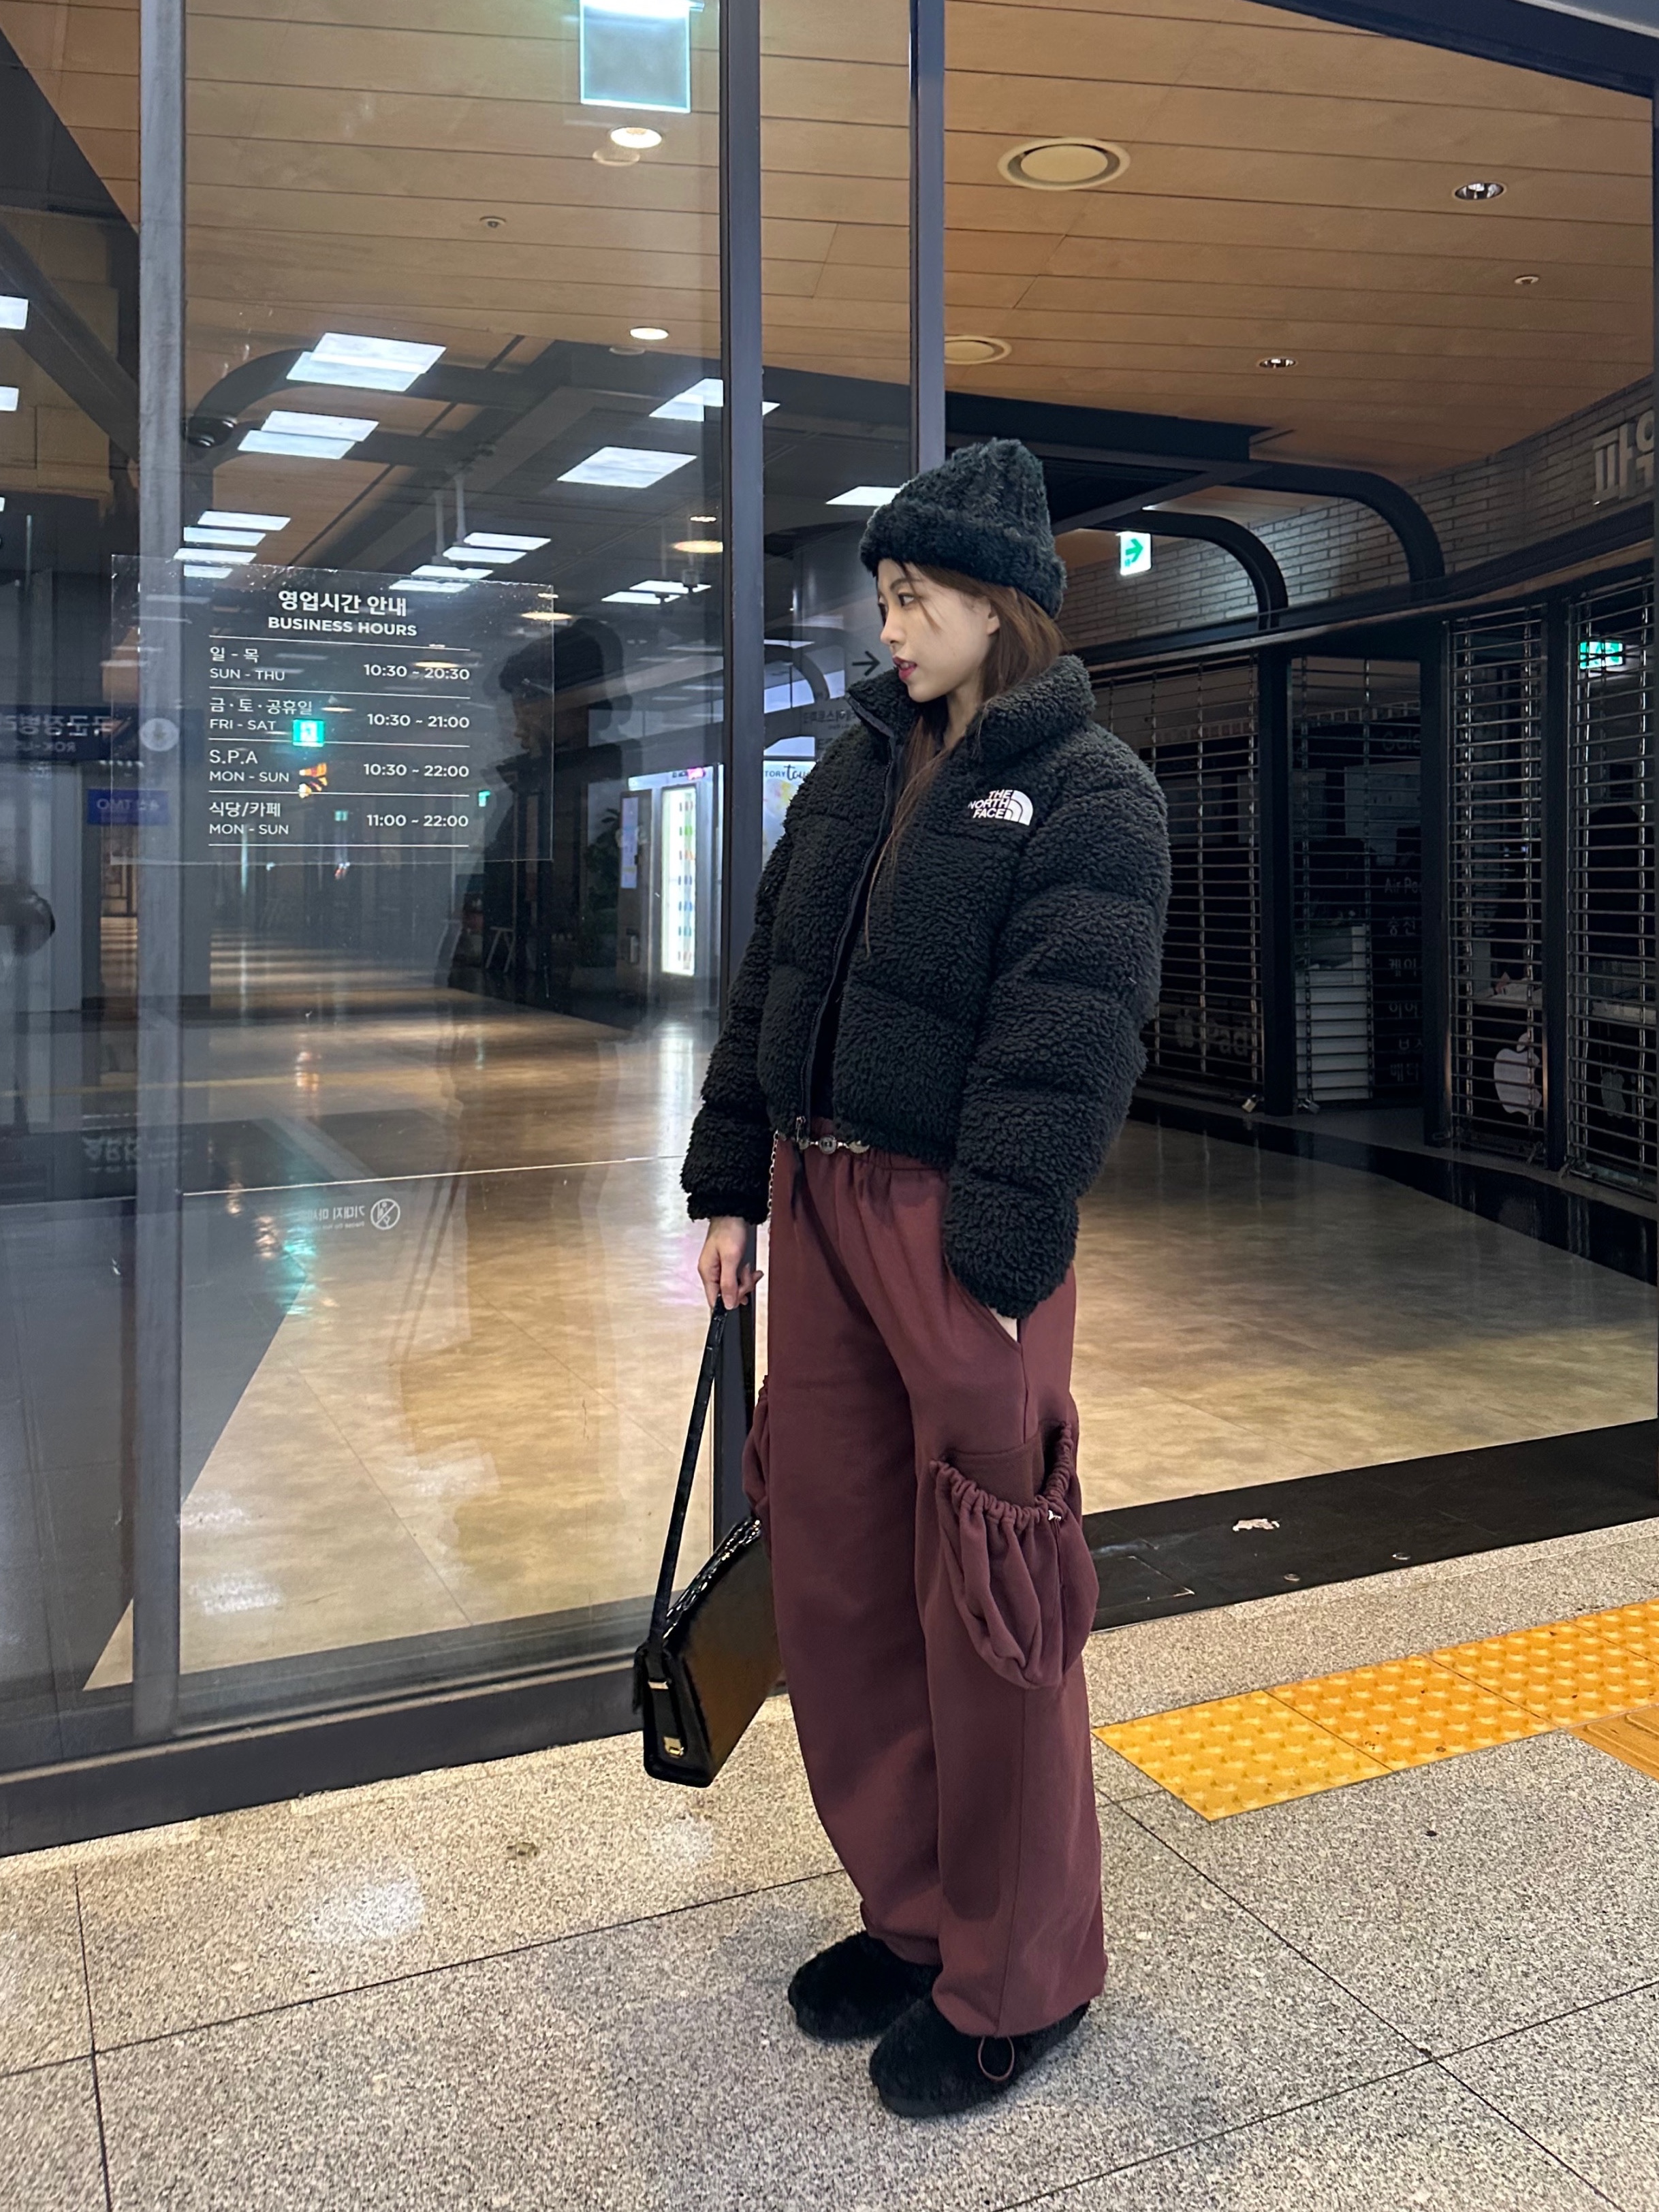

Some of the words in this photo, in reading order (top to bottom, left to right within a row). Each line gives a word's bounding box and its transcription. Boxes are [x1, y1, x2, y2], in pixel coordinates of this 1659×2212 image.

[278, 590, 362, 614] 영업시간
[366, 596, 407, 617] 안내
[268, 616, 353, 633] BUSINESS
[358, 622, 417, 636] HOURS
[209, 646, 225, 663] 일
[244, 648, 259, 663] 목
[209, 667, 240, 680] SUN
[255, 669, 285, 681] THU
[363, 663, 407, 678] 10:30
[424, 667, 471, 680] 20:30
[209, 718, 233, 729] FRI
[247, 720, 276, 731] SAT
[366, 713, 411, 727] 10:30
[427, 715, 470, 729] 21:00
[208, 749, 258, 765] S.P.A
[208, 771, 245, 782] MON
[259, 772, 289, 783] SUN
[363, 763, 407, 776] 10:30
[424, 764, 470, 778] 22:00
[988, 789, 1013, 800] THE
[208, 802, 281, 817] 식당/카페
[967, 798, 1010, 810] NORTH
[366, 814, 407, 827] 11:00
[423, 815, 469, 827] 22:00
[973, 808, 1006, 819] FACE
[208, 823, 244, 835] MON
[258, 824, 289, 836] SUN
